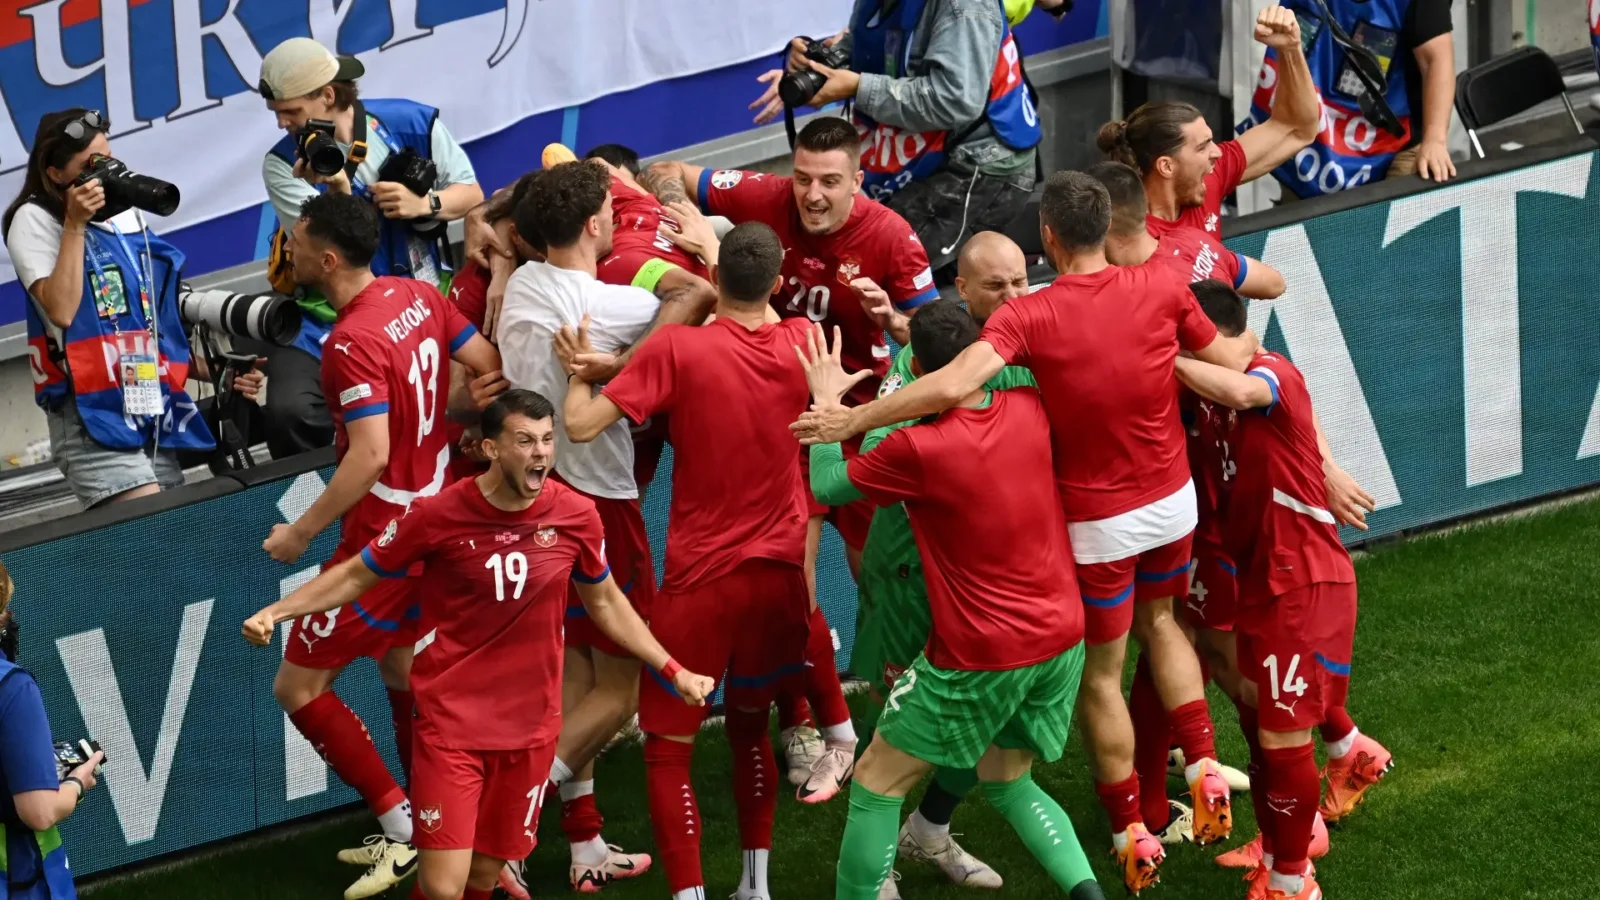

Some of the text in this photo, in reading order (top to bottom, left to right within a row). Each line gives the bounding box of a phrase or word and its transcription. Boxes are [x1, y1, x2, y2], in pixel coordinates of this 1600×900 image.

[786, 276, 830, 322] 20
[408, 337, 439, 447] 13
[485, 551, 528, 601] 19
[1263, 654, 1308, 700] 14
